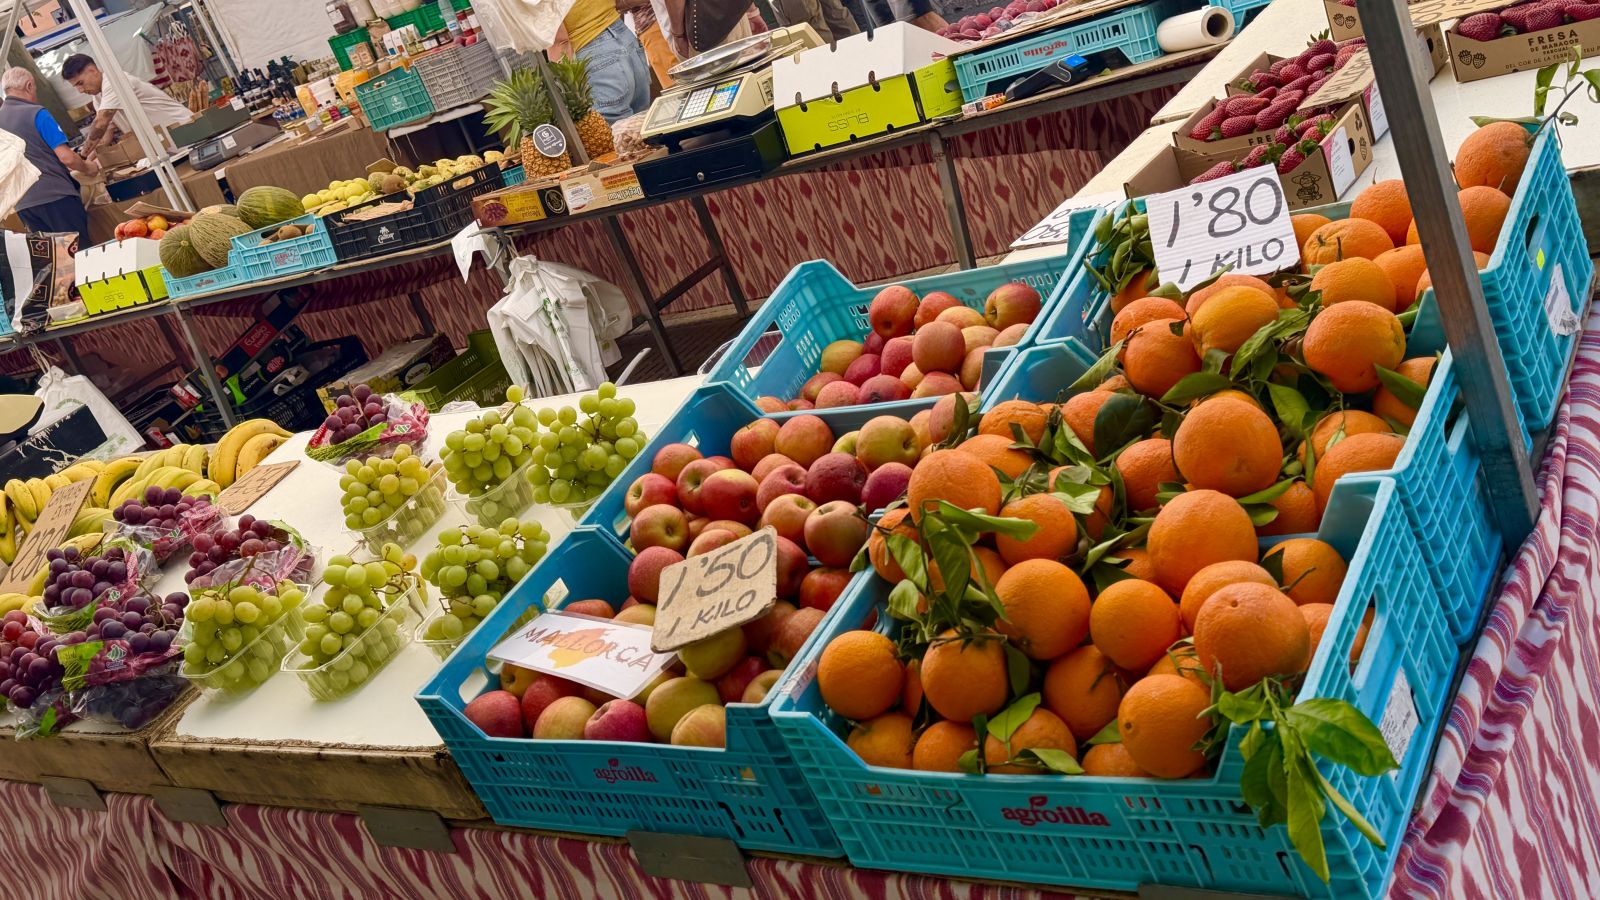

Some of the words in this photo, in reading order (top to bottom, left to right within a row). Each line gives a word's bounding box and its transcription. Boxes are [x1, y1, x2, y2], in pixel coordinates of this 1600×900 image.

[1527, 29, 1579, 47] FRESA
[1542, 38, 1579, 50] MANACOR
[1023, 40, 1068, 58] agroilla
[1248, 134, 1272, 146] FRE
[1166, 177, 1283, 248] 1'80
[1178, 259, 1192, 284] 1
[1210, 237, 1284, 274] KILO
[661, 533, 775, 611] 1'50
[666, 617, 681, 637] 1
[690, 589, 757, 630] KILO
[516, 627, 655, 673] MALLORCA
[593, 764, 658, 784] agroilla
[1001, 806, 1111, 827] agroilla
